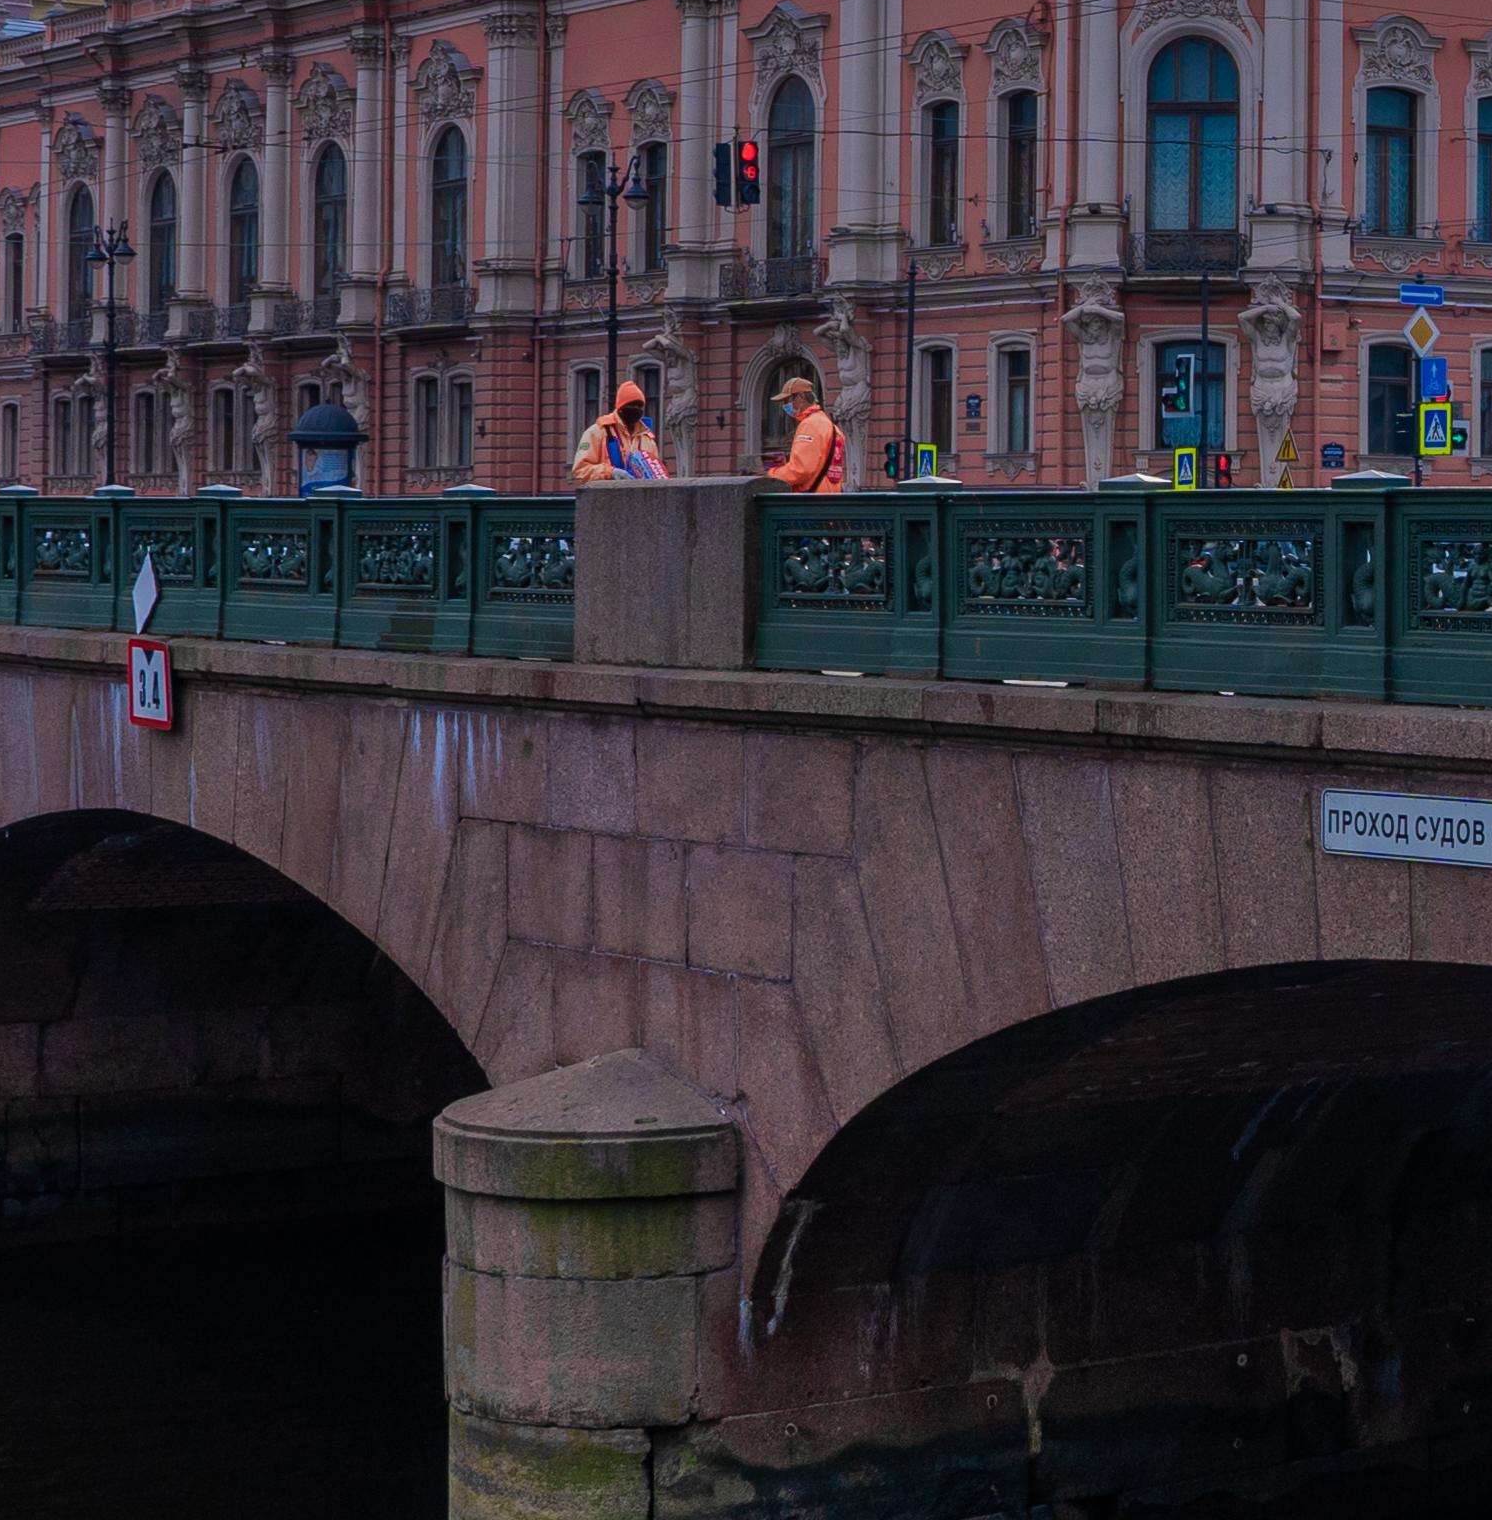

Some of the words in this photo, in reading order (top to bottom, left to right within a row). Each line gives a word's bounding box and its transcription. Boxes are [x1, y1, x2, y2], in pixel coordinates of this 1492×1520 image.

[139, 669, 161, 709] 3.4
[1328, 809, 1409, 845] ПРОХОД
[1415, 815, 1485, 848] СУДОВ
